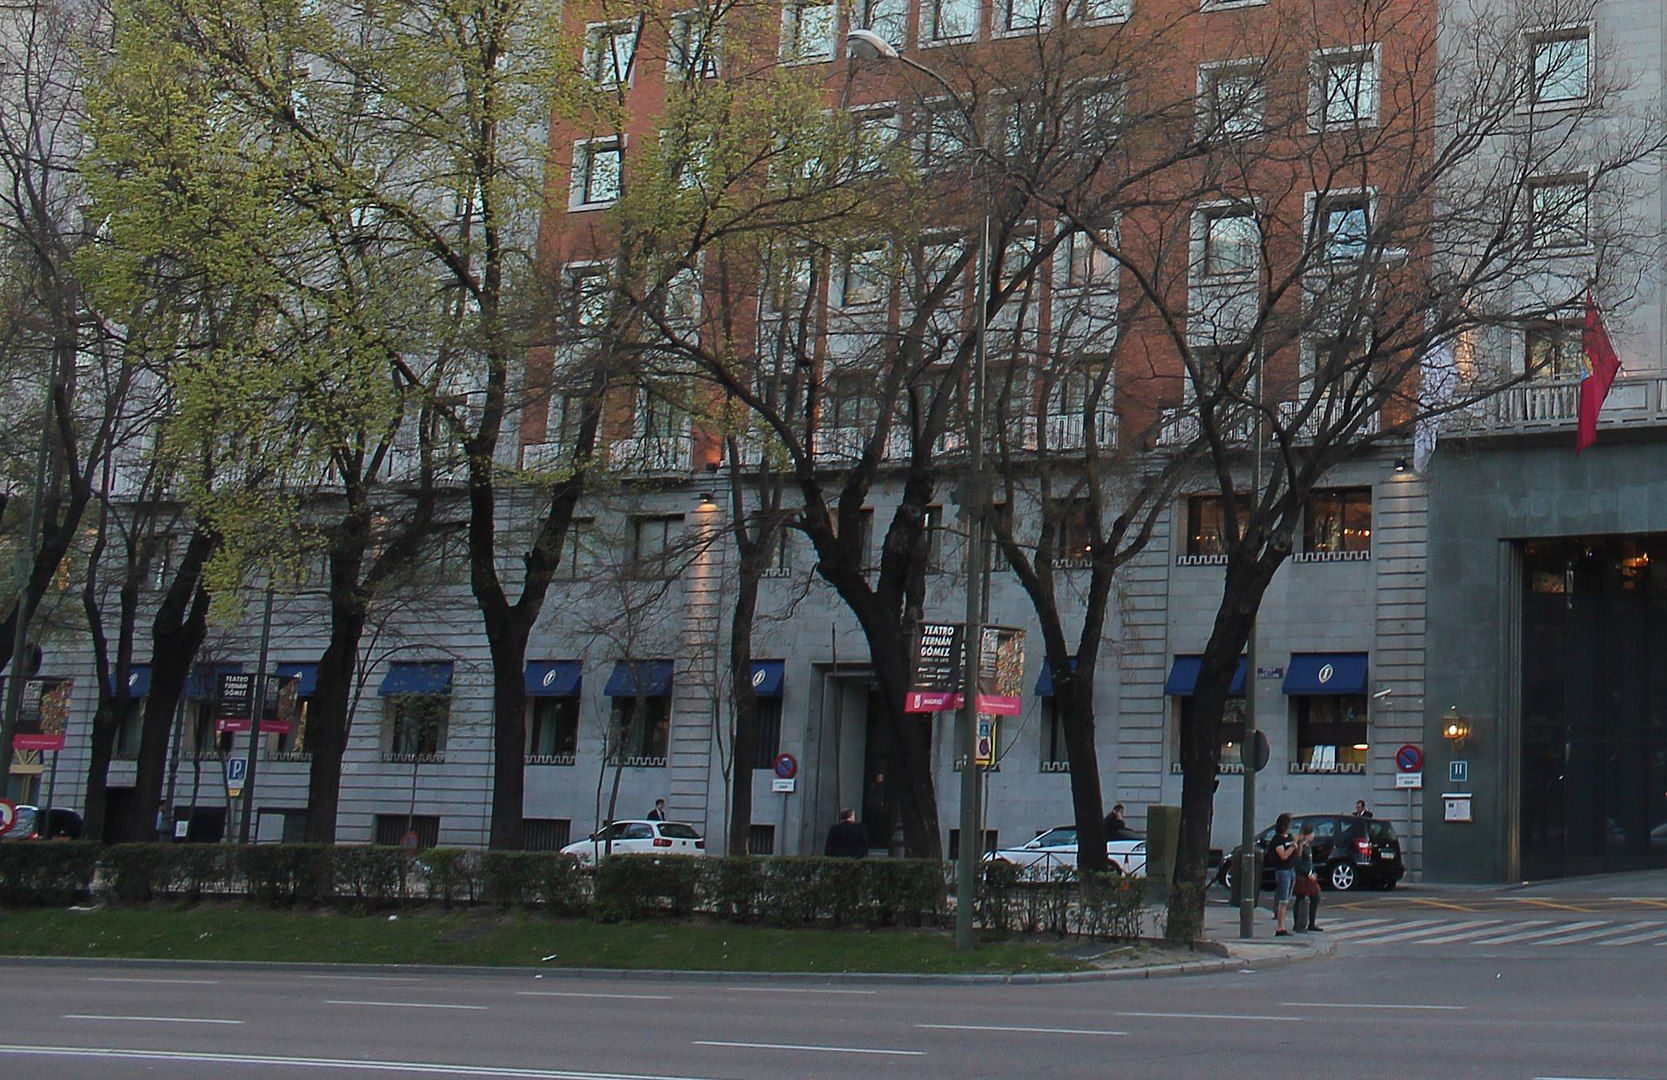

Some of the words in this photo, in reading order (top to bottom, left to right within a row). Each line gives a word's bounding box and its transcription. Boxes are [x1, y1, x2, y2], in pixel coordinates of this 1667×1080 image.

[924, 626, 954, 635] TEATRO
[921, 636, 952, 645] FERNÁN
[921, 646, 950, 656] GÓMEZ
[233, 761, 243, 778] P
